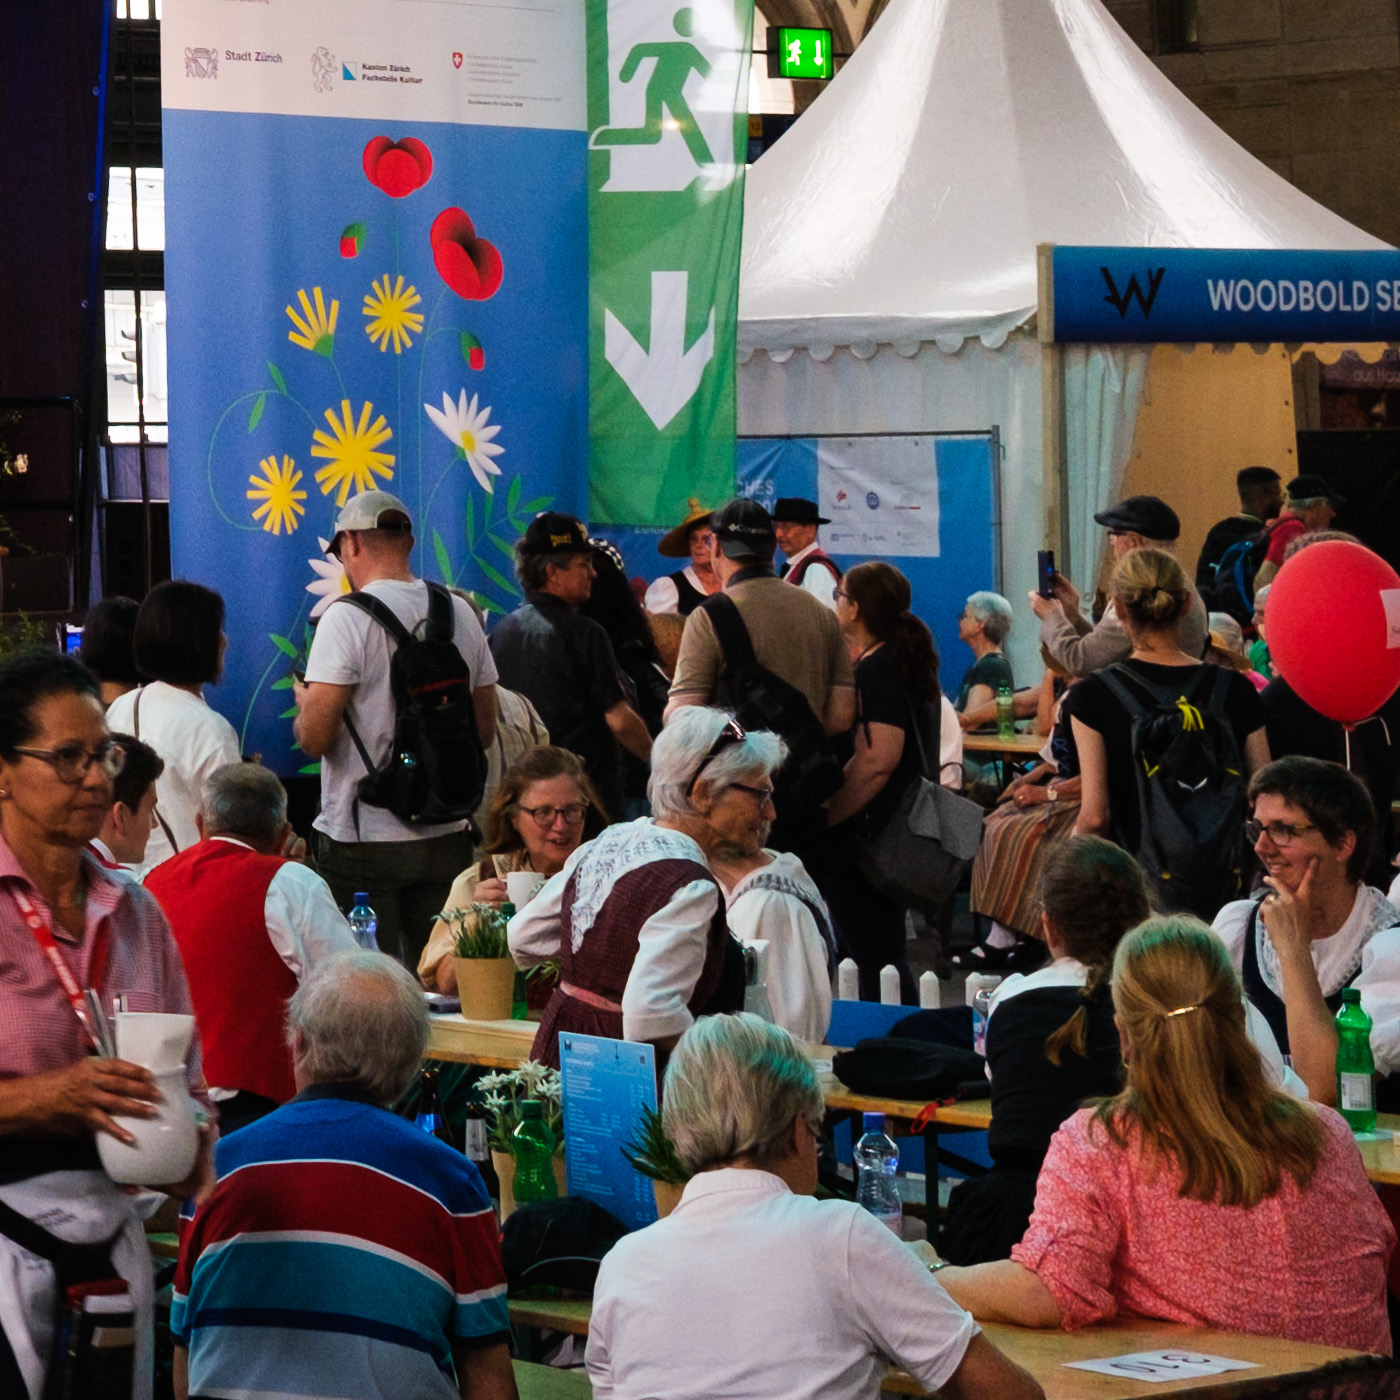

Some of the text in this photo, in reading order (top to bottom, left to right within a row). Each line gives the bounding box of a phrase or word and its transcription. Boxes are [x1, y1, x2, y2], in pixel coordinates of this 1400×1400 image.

[225, 49, 283, 64] Stadt Zürich
[1207, 278, 1370, 312] WOODBOLD
